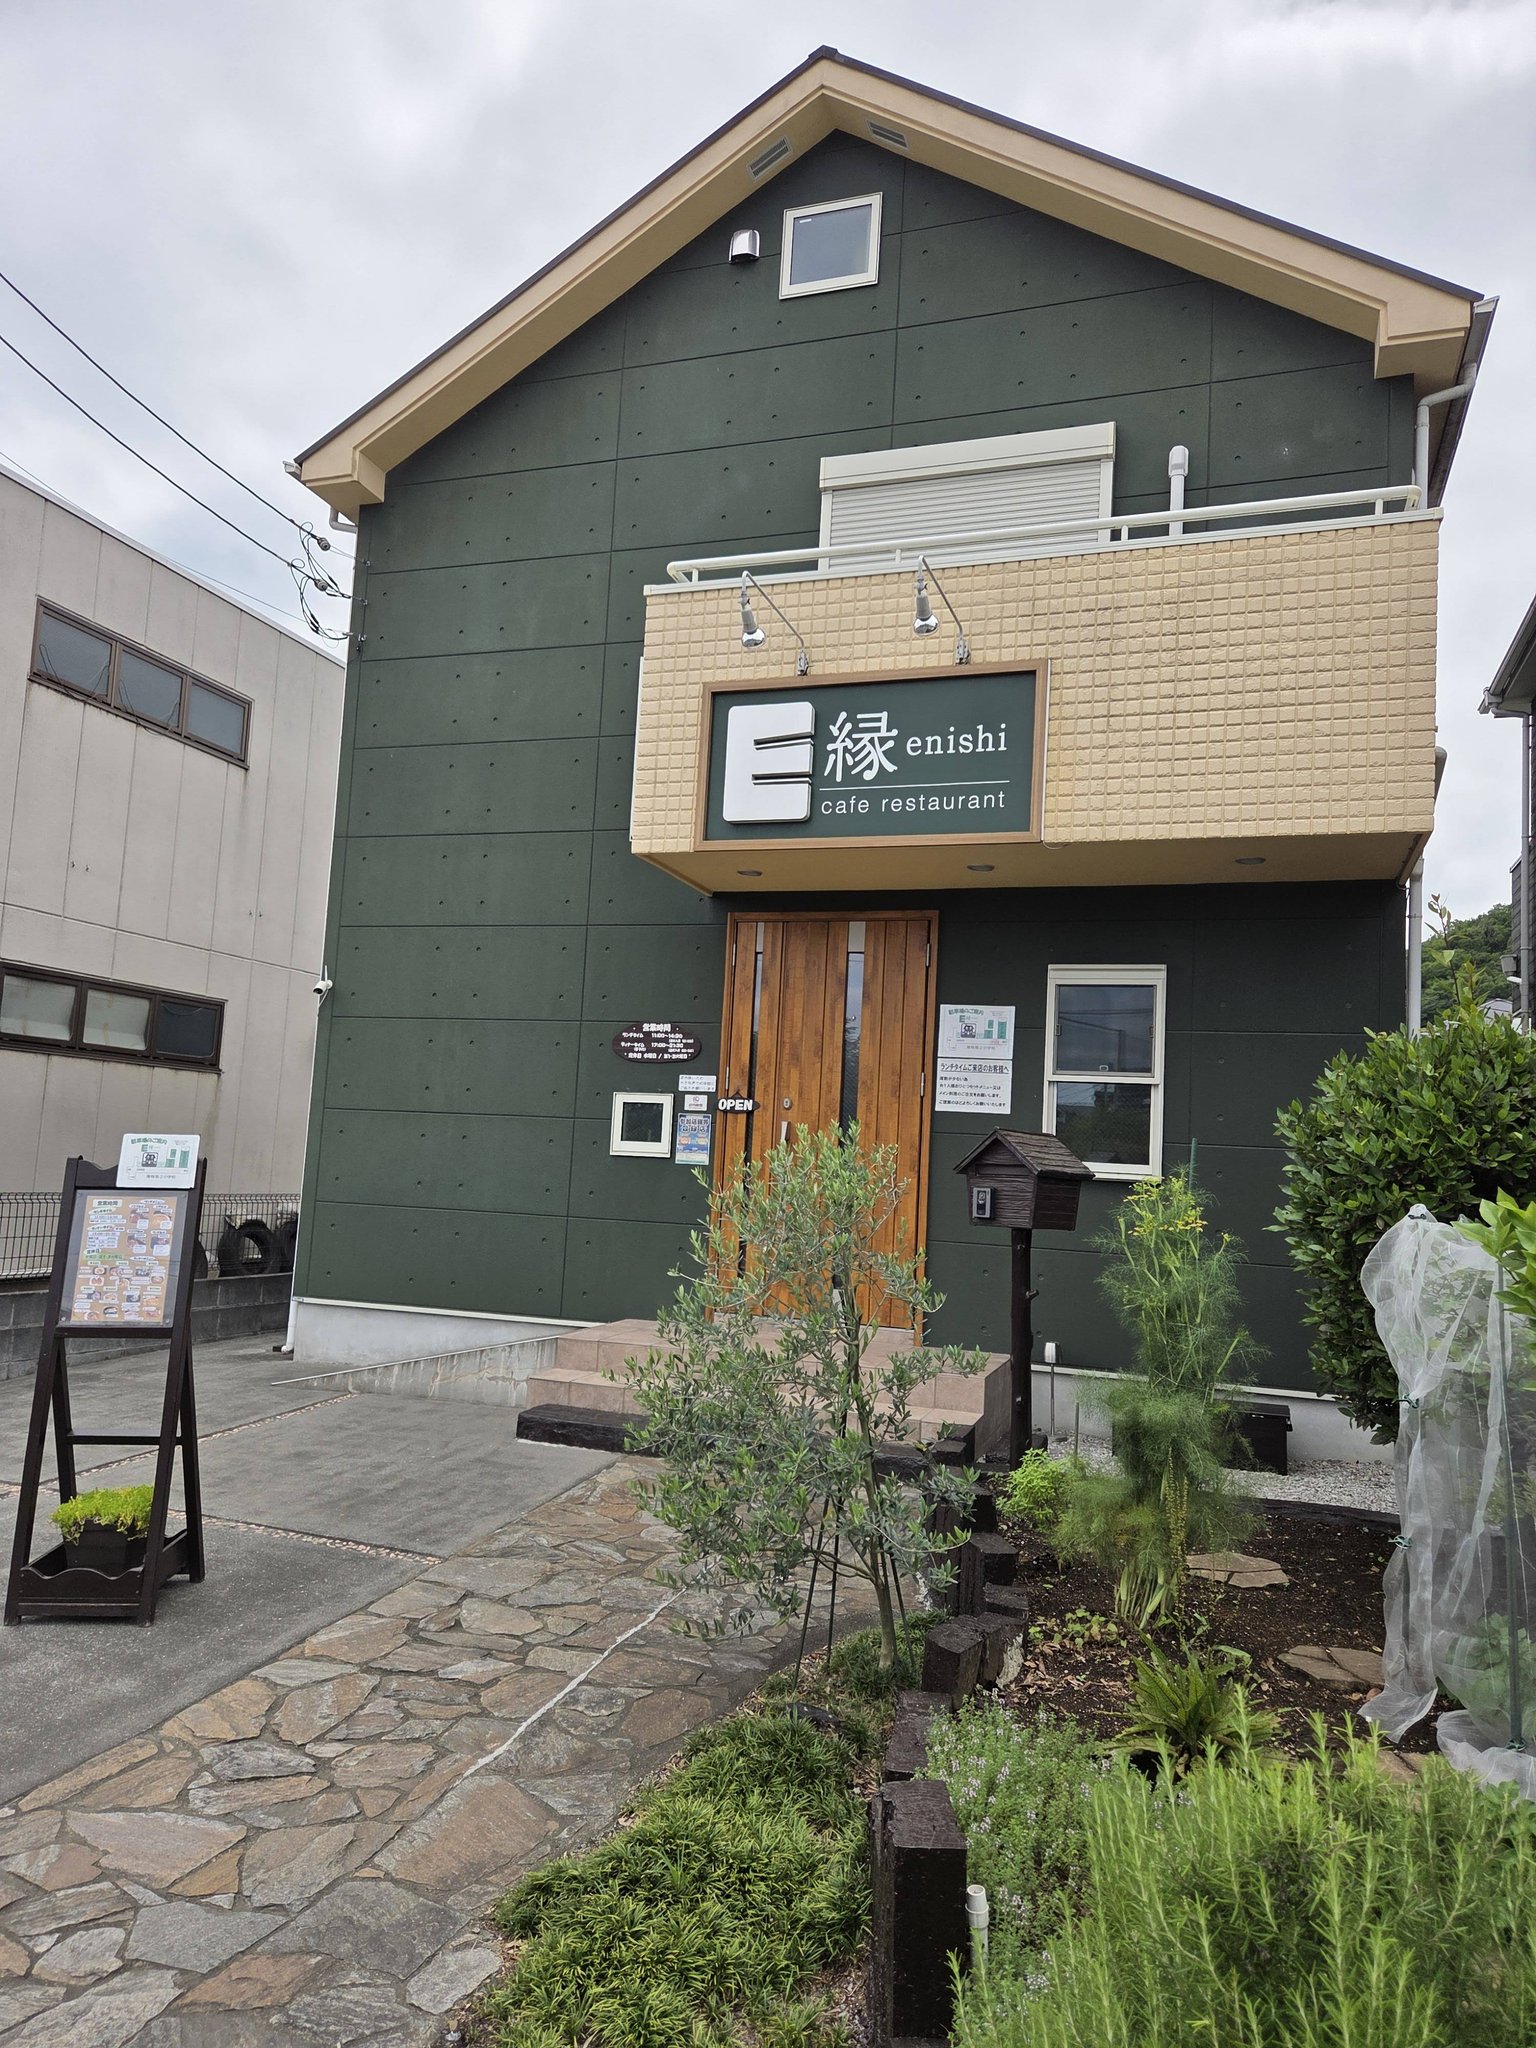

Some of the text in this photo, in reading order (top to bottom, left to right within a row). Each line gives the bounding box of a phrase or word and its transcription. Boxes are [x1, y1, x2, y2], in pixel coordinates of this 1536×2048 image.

[824, 711, 898, 782] 縁
[906, 723, 1007, 756] enishi
[821, 790, 1005, 814] cafe restaurant
[642, 1023, 671, 1032] 営業時間
[940, 1063, 1009, 1073] ランチタイムご来店のお客様へ
[718, 1098, 753, 1111] OPEN
